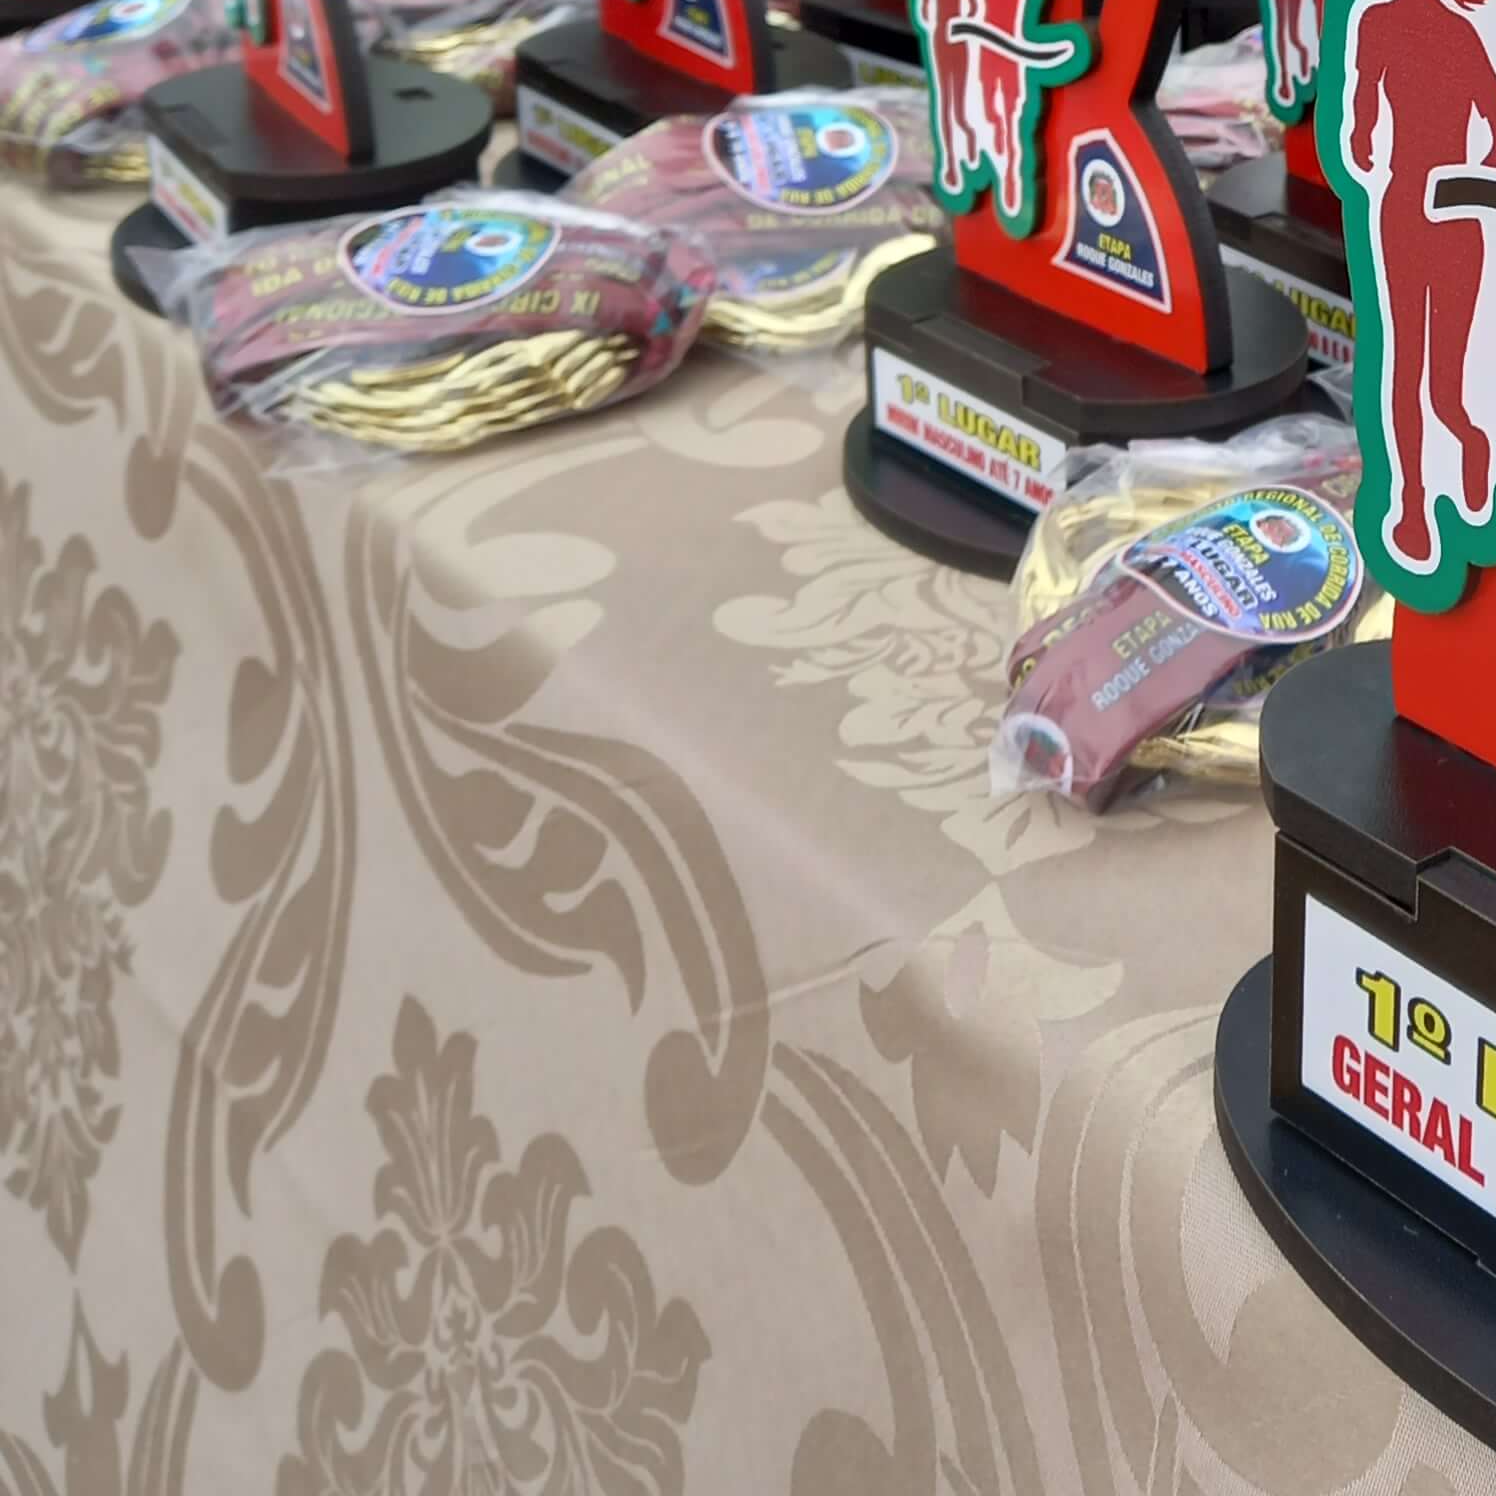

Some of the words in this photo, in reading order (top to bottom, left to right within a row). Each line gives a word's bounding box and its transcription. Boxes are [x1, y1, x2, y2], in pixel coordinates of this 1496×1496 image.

[937, 391, 1042, 472] LUGAR
[1223, 522, 1271, 566] ETAPA
[1313, 543, 1351, 610] CORRIDA
[1111, 608, 1173, 662] ETAPA
[1258, 612, 1298, 632] RUA
[1295, 600, 1323, 626] DE
[1091, 659, 1151, 713] ROQUE
[1355, 965, 1454, 1066] 1º
[1330, 1033, 1487, 1188] GERAL
